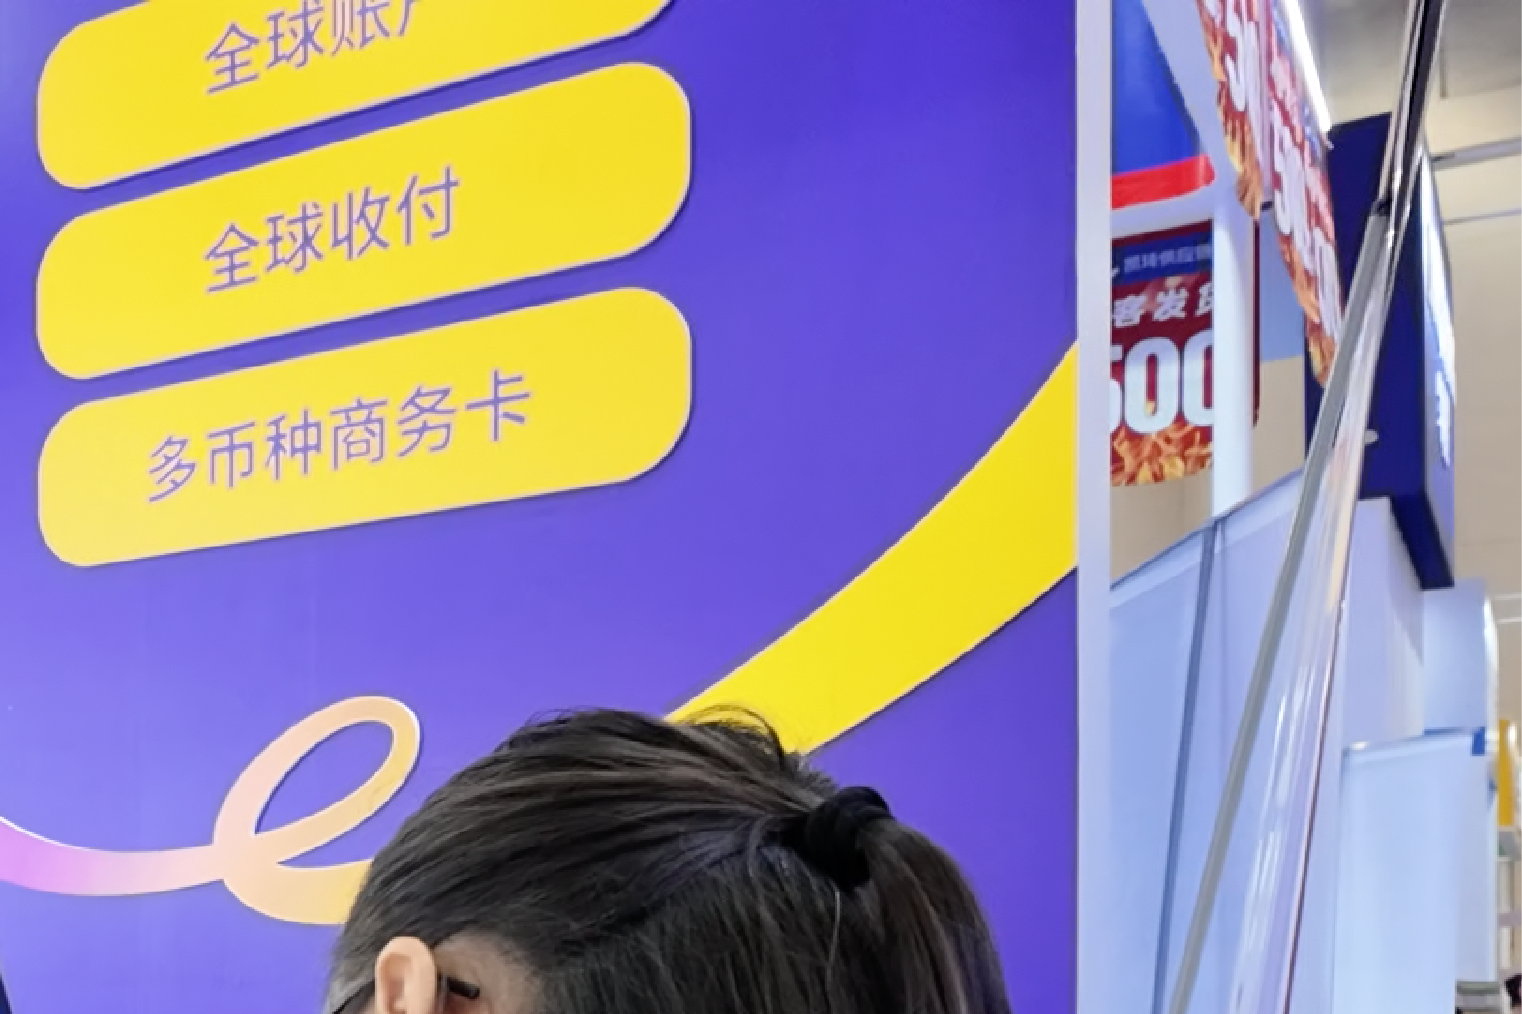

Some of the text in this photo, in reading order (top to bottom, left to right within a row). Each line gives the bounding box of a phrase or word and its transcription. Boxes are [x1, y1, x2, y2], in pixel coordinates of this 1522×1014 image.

[204, 165, 460, 293] 全球收付
[148, 368, 531, 502] 多币种商务卡
[1110, 326, 1213, 434] 00
